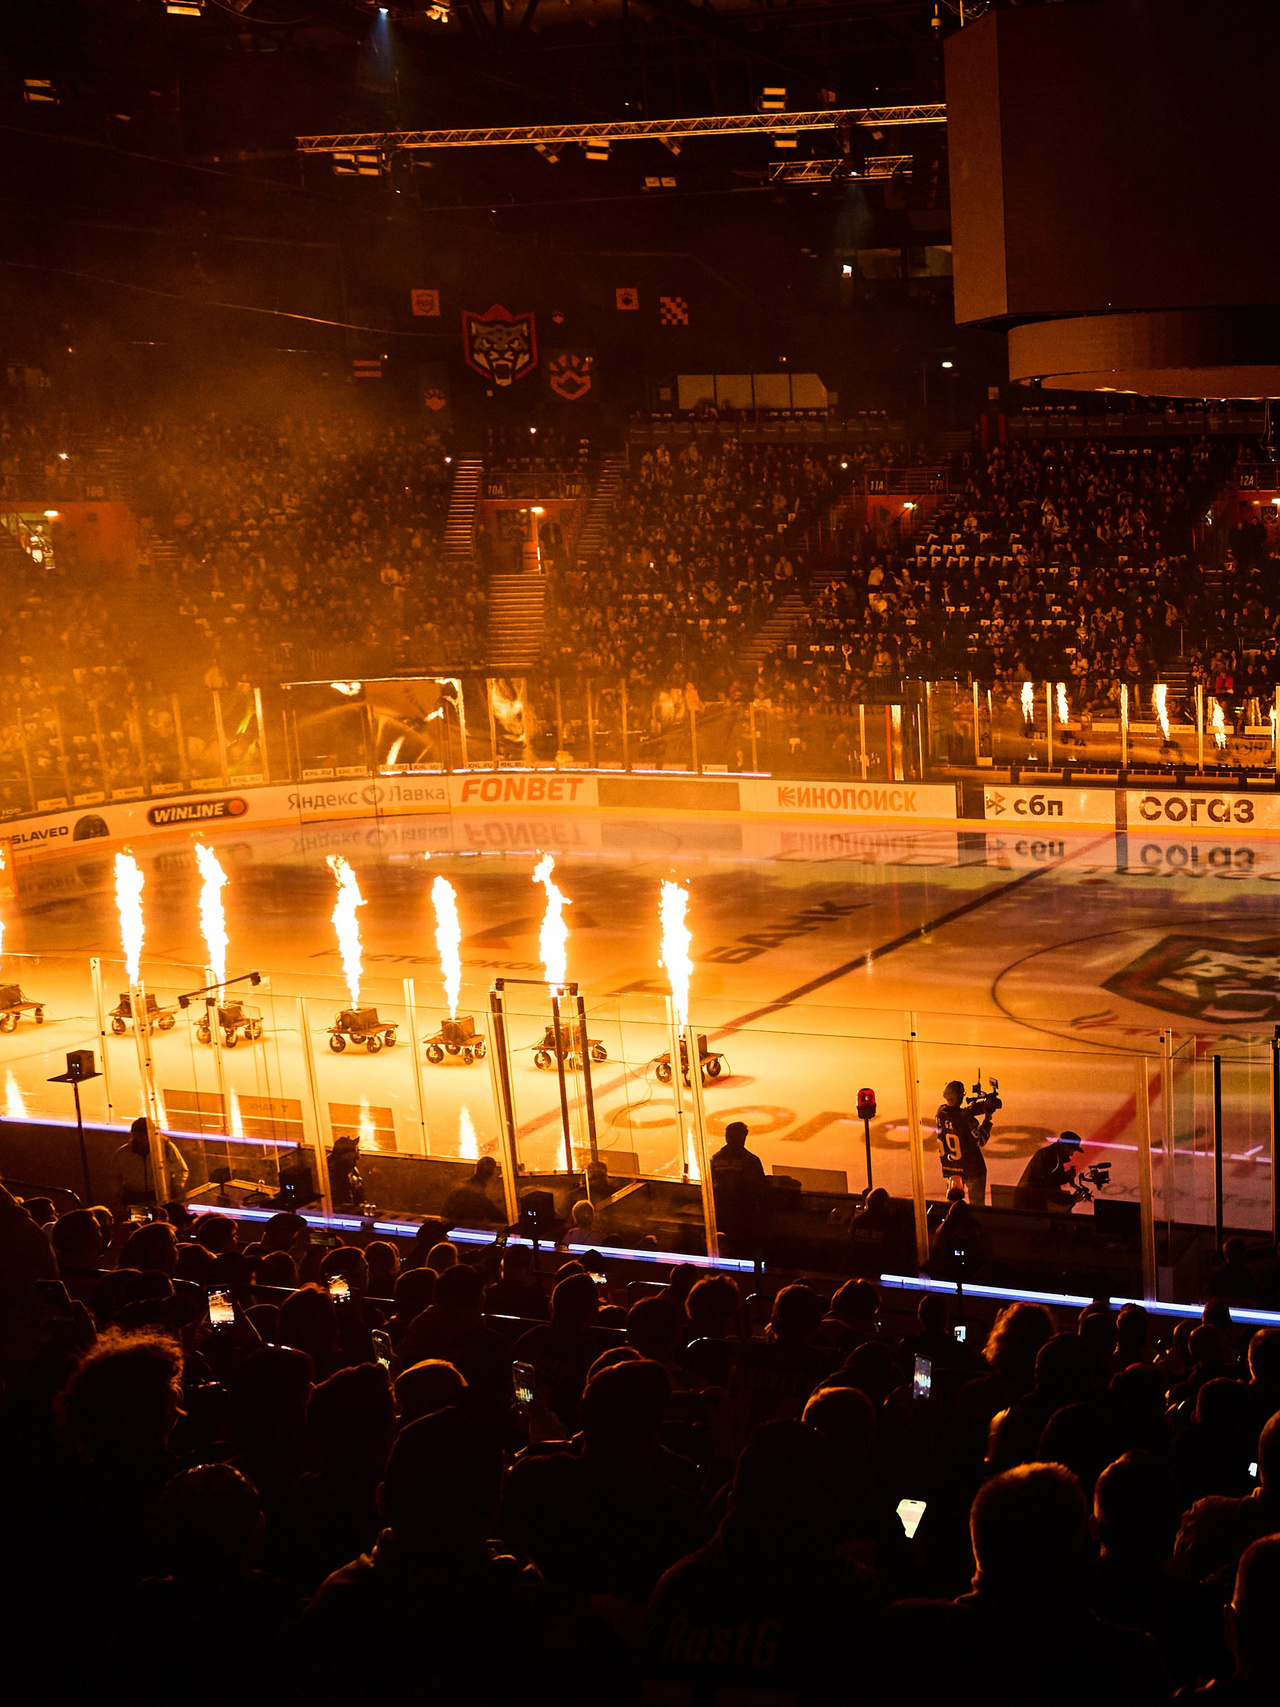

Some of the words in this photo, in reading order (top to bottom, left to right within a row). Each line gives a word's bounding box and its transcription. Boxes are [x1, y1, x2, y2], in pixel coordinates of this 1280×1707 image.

[287, 790, 358, 811] Яндекс
[388, 785, 446, 802] Лавка
[461, 777, 584, 803] FONBET
[777, 786, 918, 812] КИНОПОИСК
[154, 801, 225, 823] WINLINE
[1013, 794, 1064, 816] сбп
[1138, 796, 1255, 824] согаз
[11, 826, 69, 845] SLAVED
[659, 1614, 782, 1669] RustG
